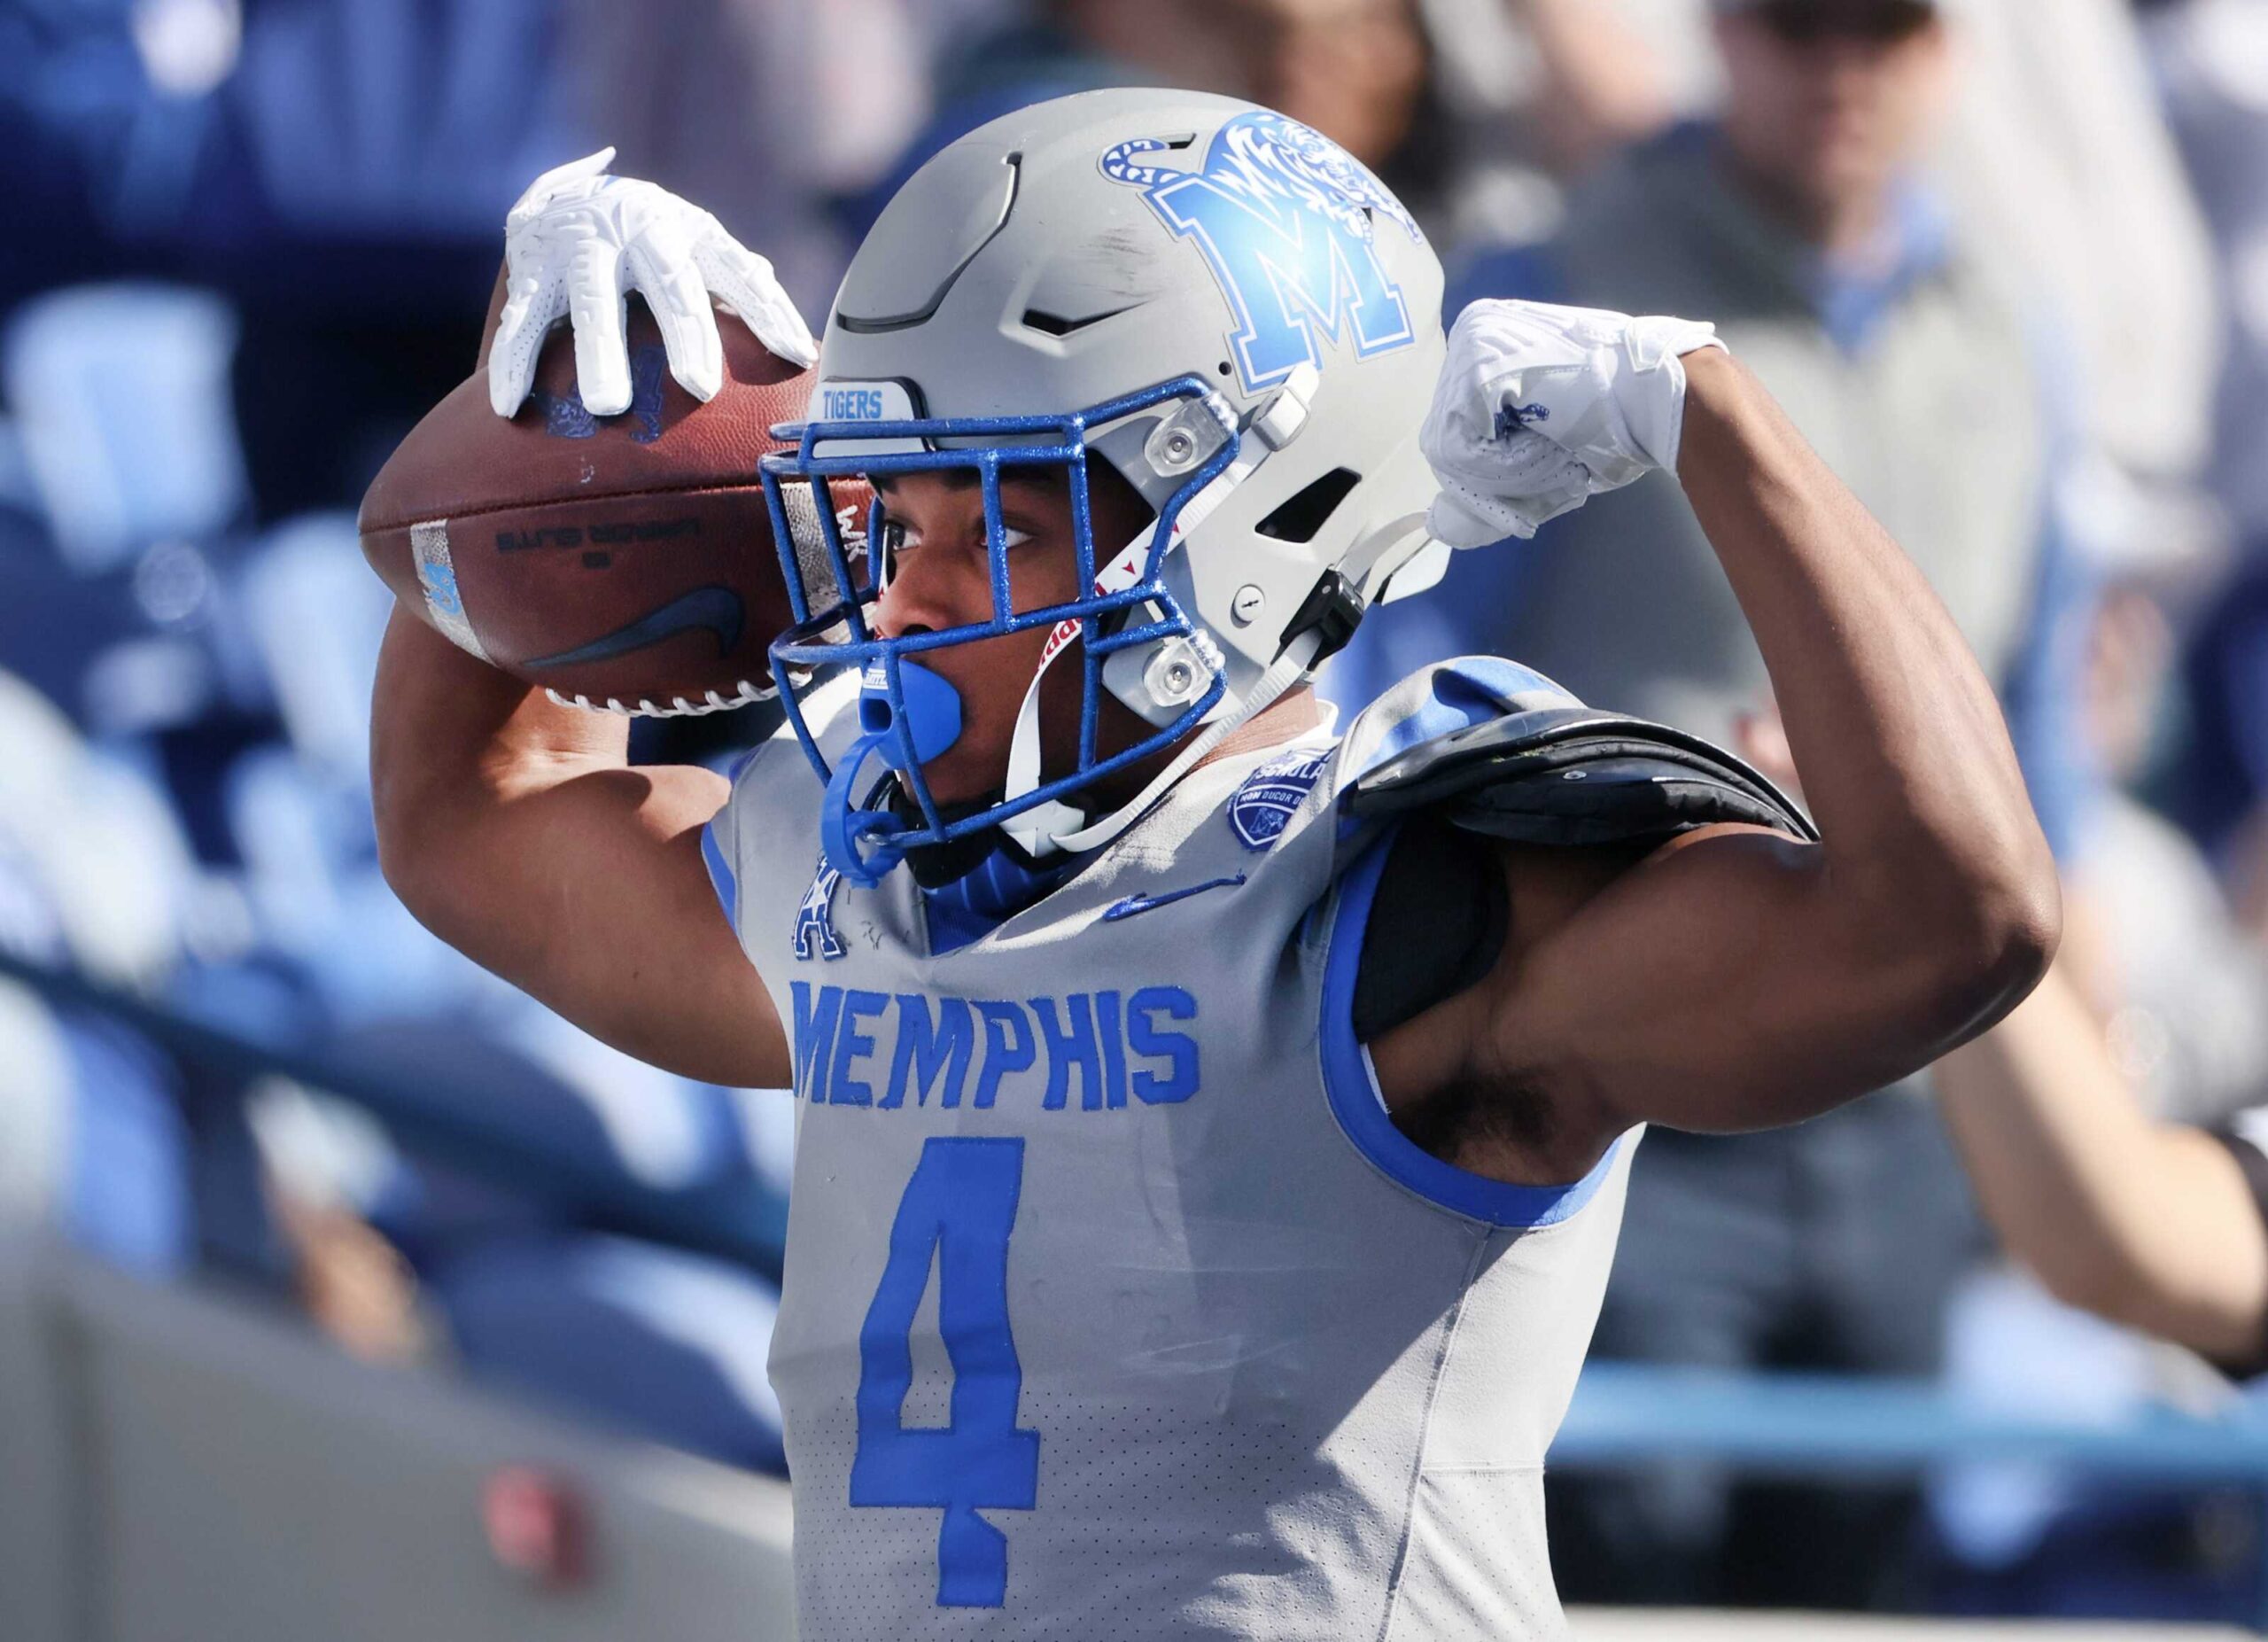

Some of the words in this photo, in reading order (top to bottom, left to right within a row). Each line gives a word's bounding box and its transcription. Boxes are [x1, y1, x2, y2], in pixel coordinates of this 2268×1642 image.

[823, 390, 883, 419] TIGERS
[1255, 761, 1326, 779] SCHOLA
[1240, 791, 1262, 803] NON
[1262, 791, 1293, 805] DUCOR
[789, 981, 1200, 1111] MEMPHIS
[848, 1136, 1040, 1607] 4
